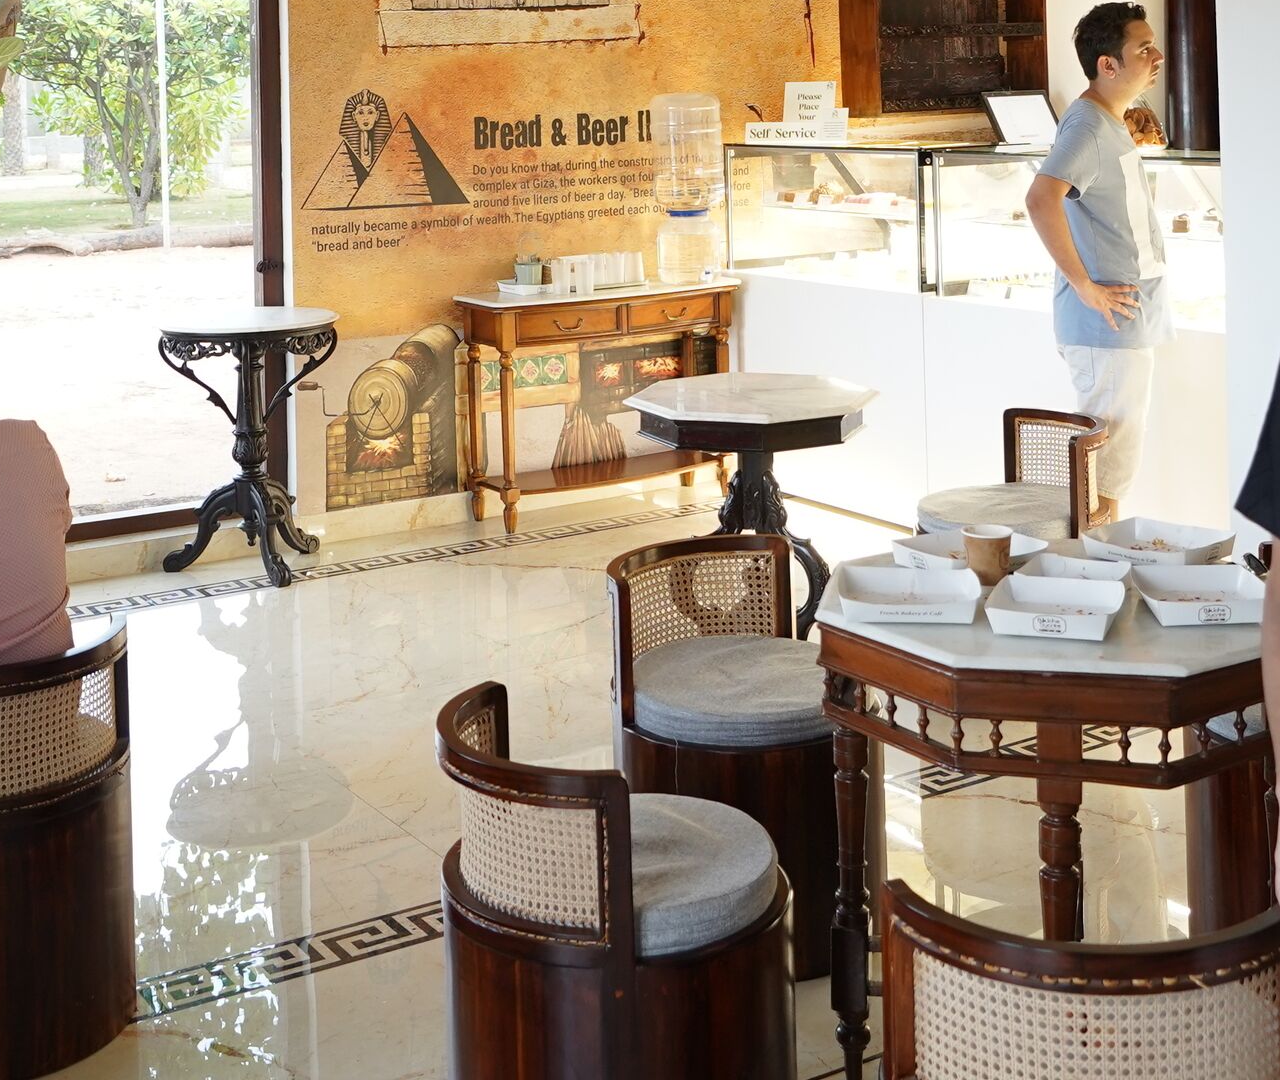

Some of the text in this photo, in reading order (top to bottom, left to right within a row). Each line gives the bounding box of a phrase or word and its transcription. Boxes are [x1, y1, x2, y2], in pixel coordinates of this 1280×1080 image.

[797, 93, 822, 101] Please
[798, 103, 820, 111] Place
[798, 113, 816, 121] Your
[474, 113, 543, 151] Bread
[551, 118, 567, 147] &
[576, 112, 629, 147] Beer
[749, 128, 771, 139] Self
[775, 127, 817, 139] Service
[472, 164, 487, 176] Do
[490, 165, 509, 180] you
[511, 162, 539, 174] know
[541, 161, 563, 174] that,
[565, 158, 597, 172] during
[600, 157, 616, 169] the
[472, 181, 517, 195] complex
[520, 179, 530, 190] at
[532, 177, 557, 190] Giza,
[560, 175, 576, 187] the
[578, 173, 617, 185] workers
[620, 172, 636, 186] got
[473, 195, 509, 208] around
[512, 193, 530, 206] five
[533, 192, 558, 205] liters
[561, 191, 572, 203] of
[574, 190, 598, 203] beer
[598, 192, 605, 201] a
[607, 189, 626, 202] day.
[311, 220, 361, 235] naturally
[363, 219, 408, 232] became
[410, 220, 417, 230] a
[420, 215, 460, 232] symbol
[462, 214, 474, 226] of
[536, 208, 585, 224] Egyptians
[587, 204, 625, 220] greeted
[627, 203, 650, 215] each
[352, 238, 373, 250] and
